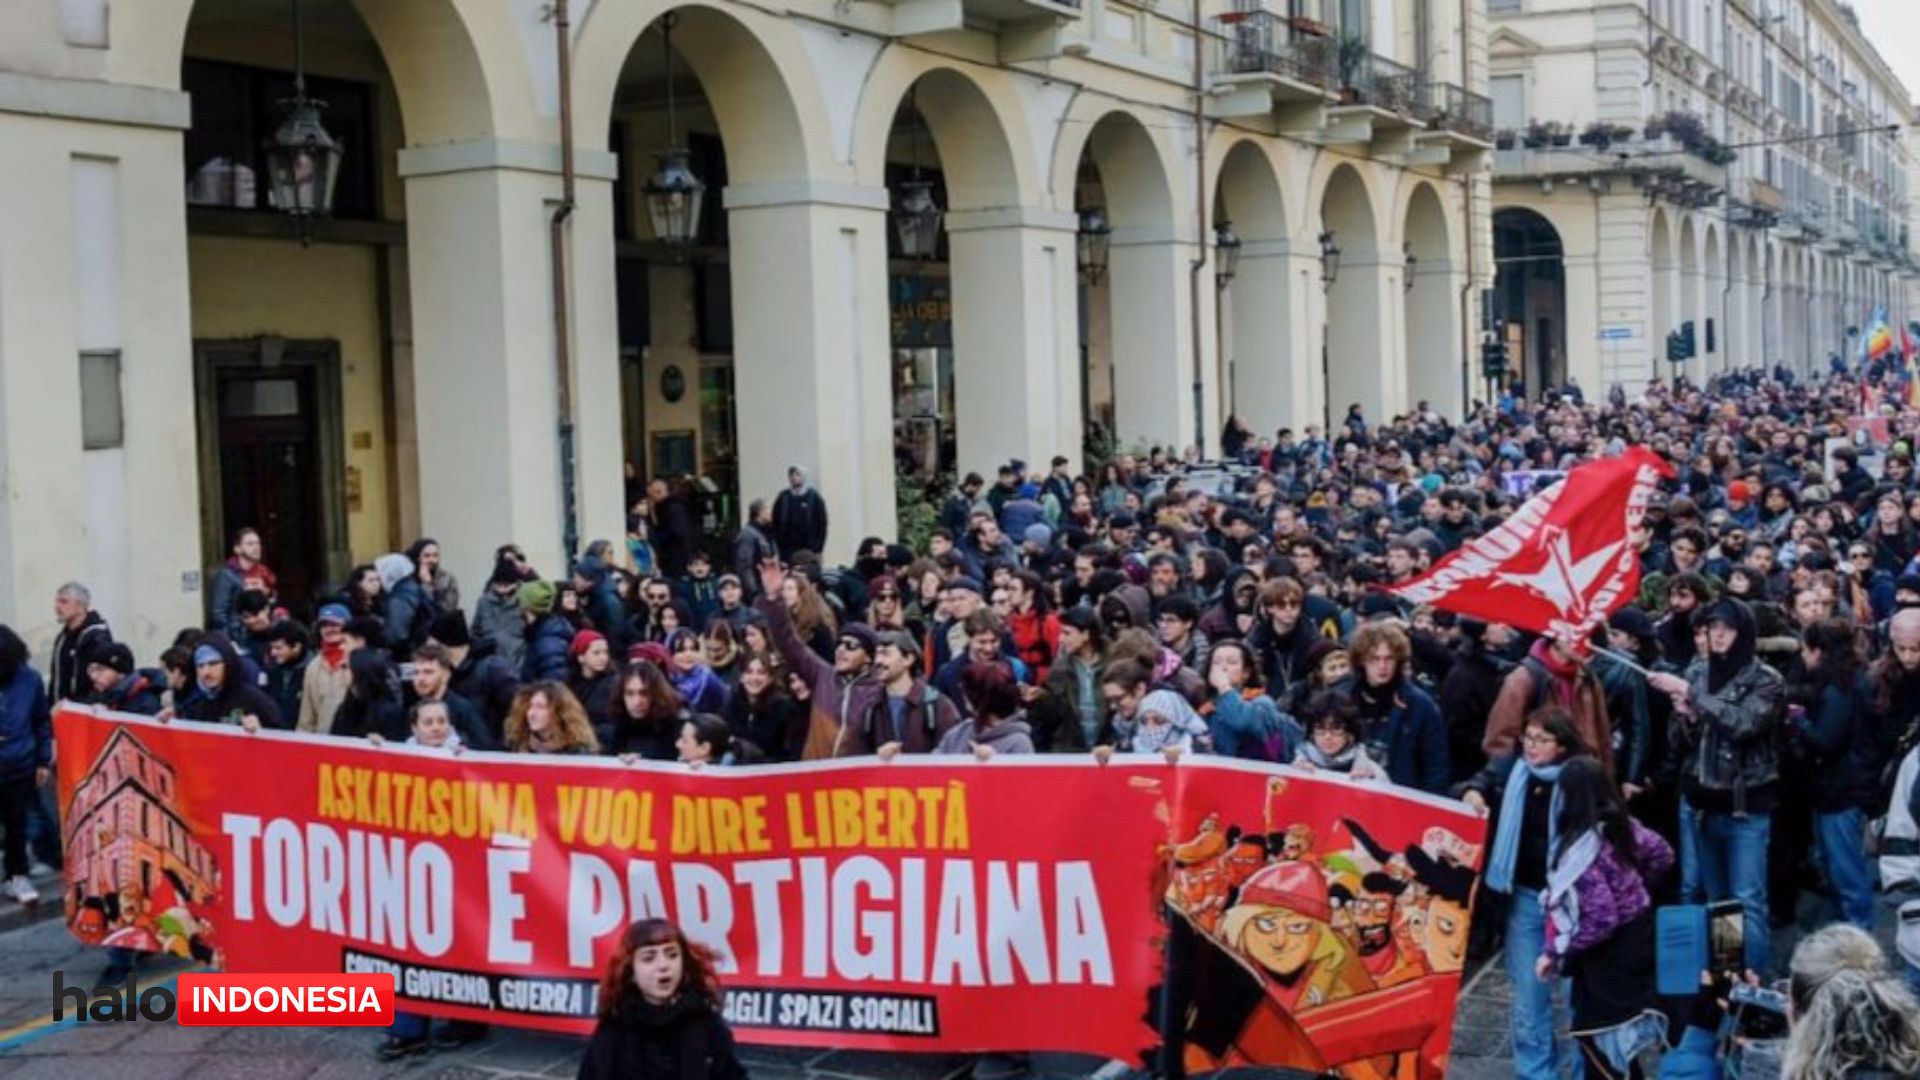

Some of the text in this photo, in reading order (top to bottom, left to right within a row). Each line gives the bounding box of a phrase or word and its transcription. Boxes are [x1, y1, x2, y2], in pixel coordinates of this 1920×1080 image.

[319, 764, 968, 854] ASKATASUNA VUOL DIRE LIBERTÀ
[223, 813, 1113, 986] TORINO È PARTIGIANA
[405, 967, 493, 1010] GOVERNO,
[498, 982, 583, 1014] GUERRA
[778, 994, 843, 1028] SPAZI
[849, 997, 934, 1033] SOCIALI
